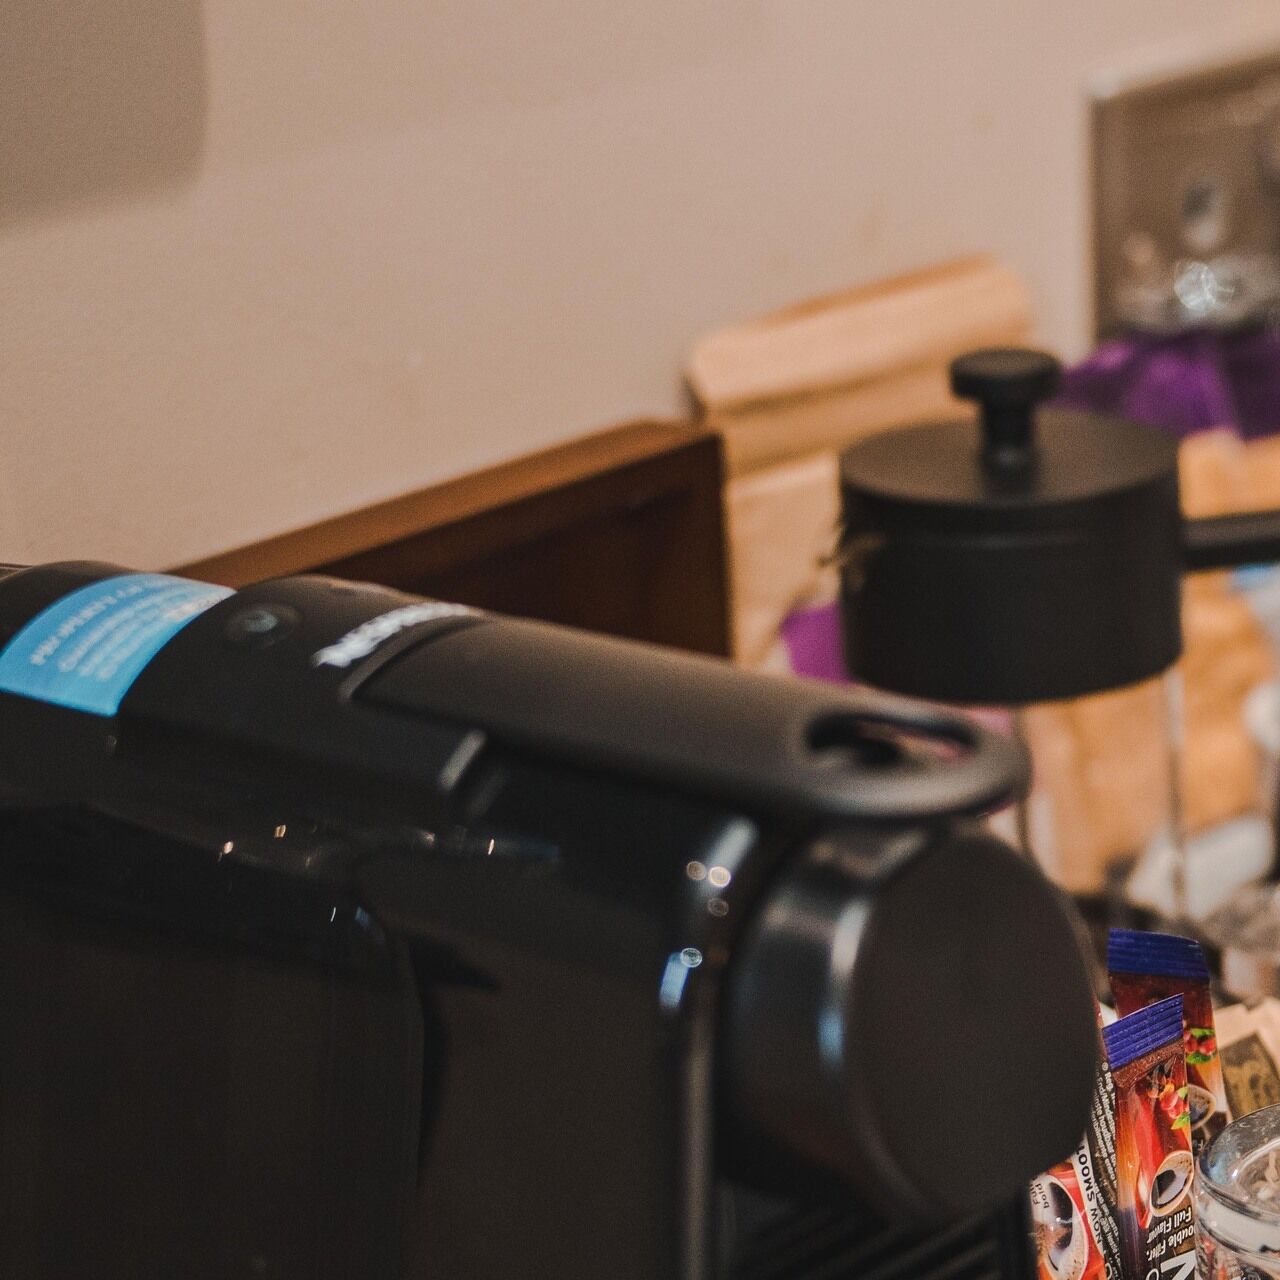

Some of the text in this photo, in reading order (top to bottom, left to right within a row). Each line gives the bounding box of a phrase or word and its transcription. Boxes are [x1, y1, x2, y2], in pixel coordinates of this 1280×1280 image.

[1035, 1183, 1050, 1209] bold
[1076, 1141, 1102, 1244] NOW SMOOT
[1173, 1206, 1192, 1228] Full
